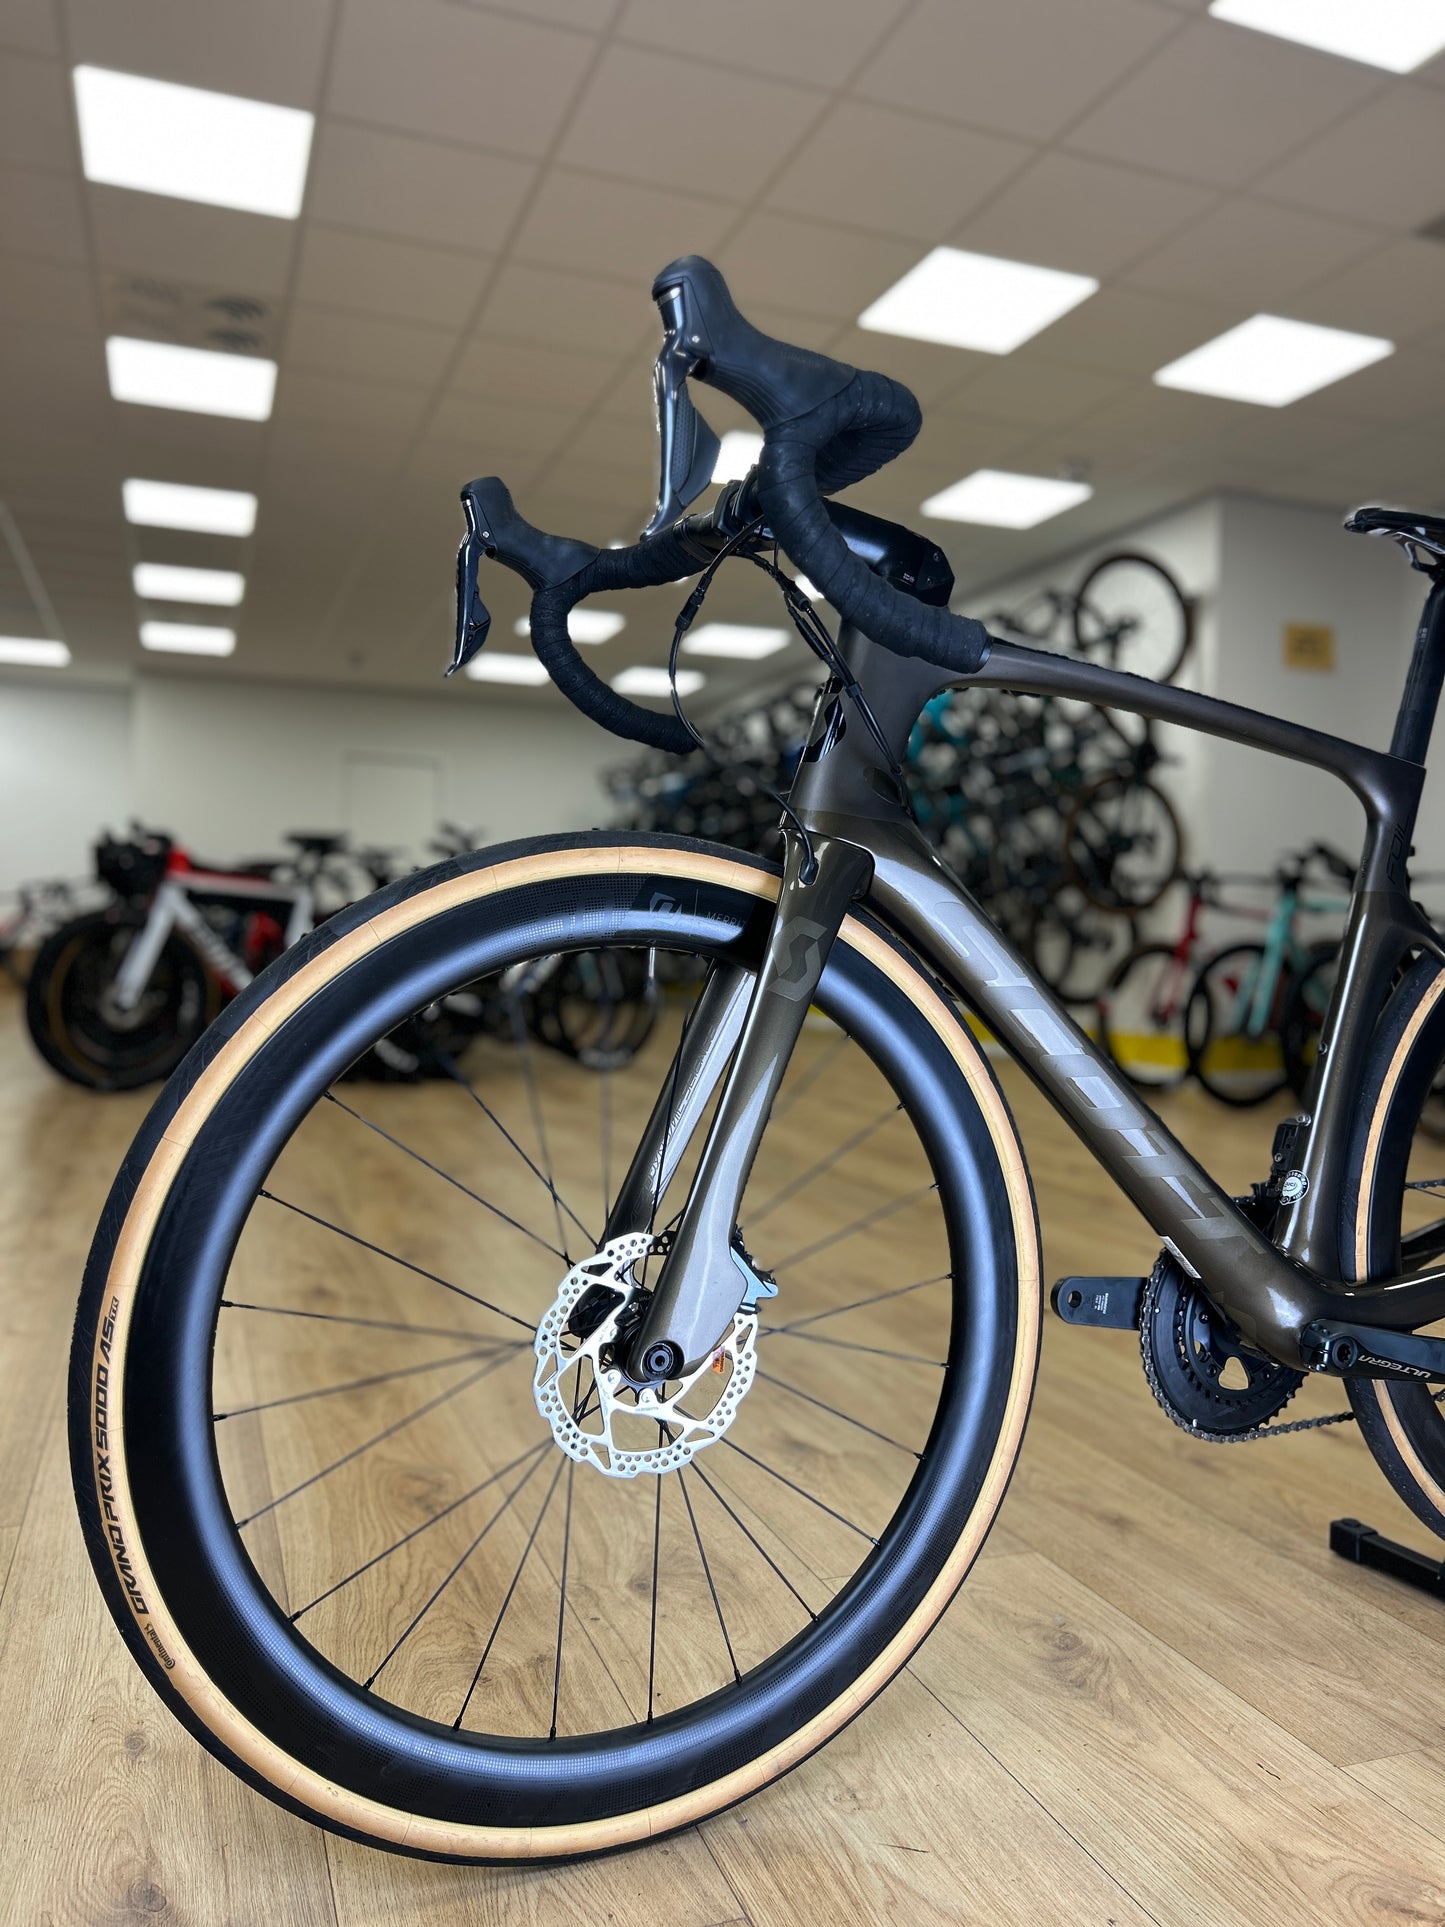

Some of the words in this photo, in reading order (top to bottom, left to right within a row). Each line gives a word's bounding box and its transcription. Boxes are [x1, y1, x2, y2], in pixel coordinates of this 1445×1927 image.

[1386, 815, 1410, 885] FOIL
[933, 900, 1266, 1255] SCOTT
[1358, 1354, 1432, 1379] ULTEGRA
[95, 1363, 109, 1450] 5000
[97, 1450, 118, 1521] PRIX
[108, 1524, 150, 1614] GRAND
[147, 1629, 176, 1670] Continental
